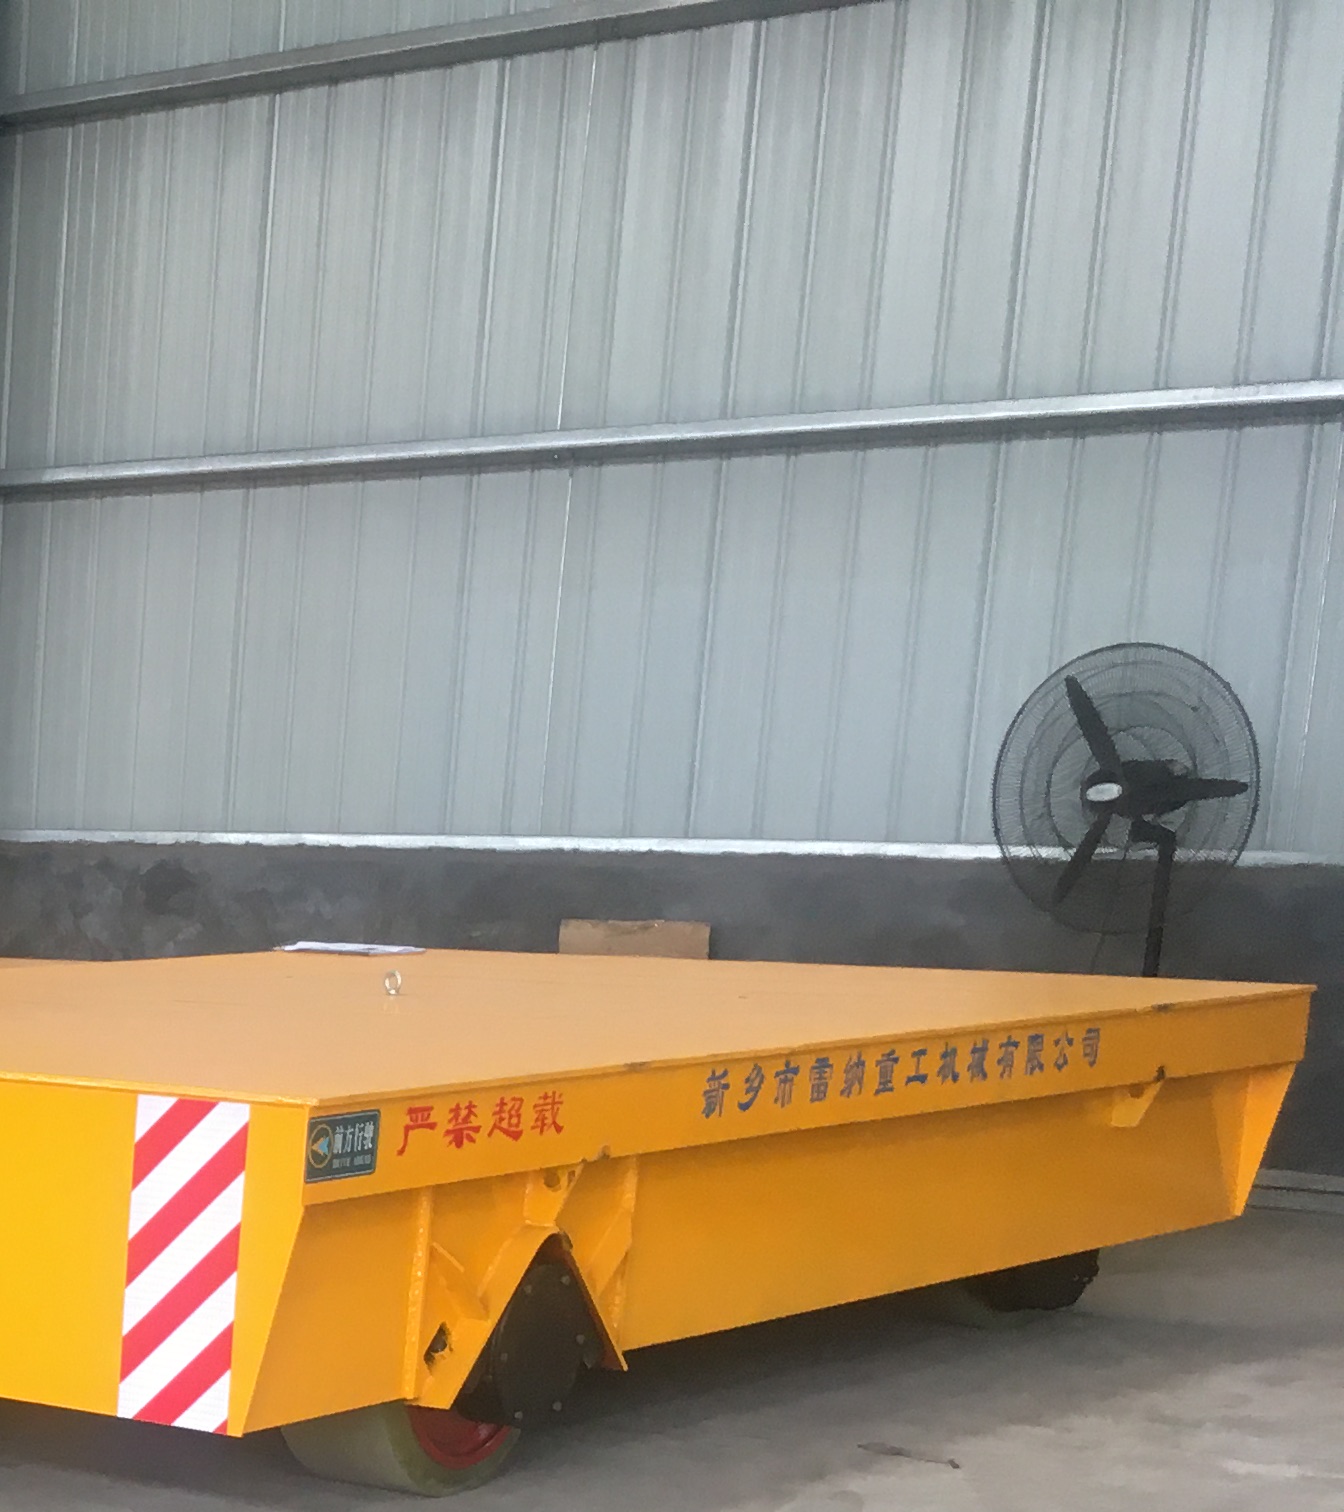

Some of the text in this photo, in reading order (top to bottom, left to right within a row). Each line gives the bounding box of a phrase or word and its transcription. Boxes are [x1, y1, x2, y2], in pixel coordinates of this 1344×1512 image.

[701, 1028, 1101, 1119] 新乡市雷纳重工机械有限公司
[395, 1090, 565, 1156] 严禁超载
